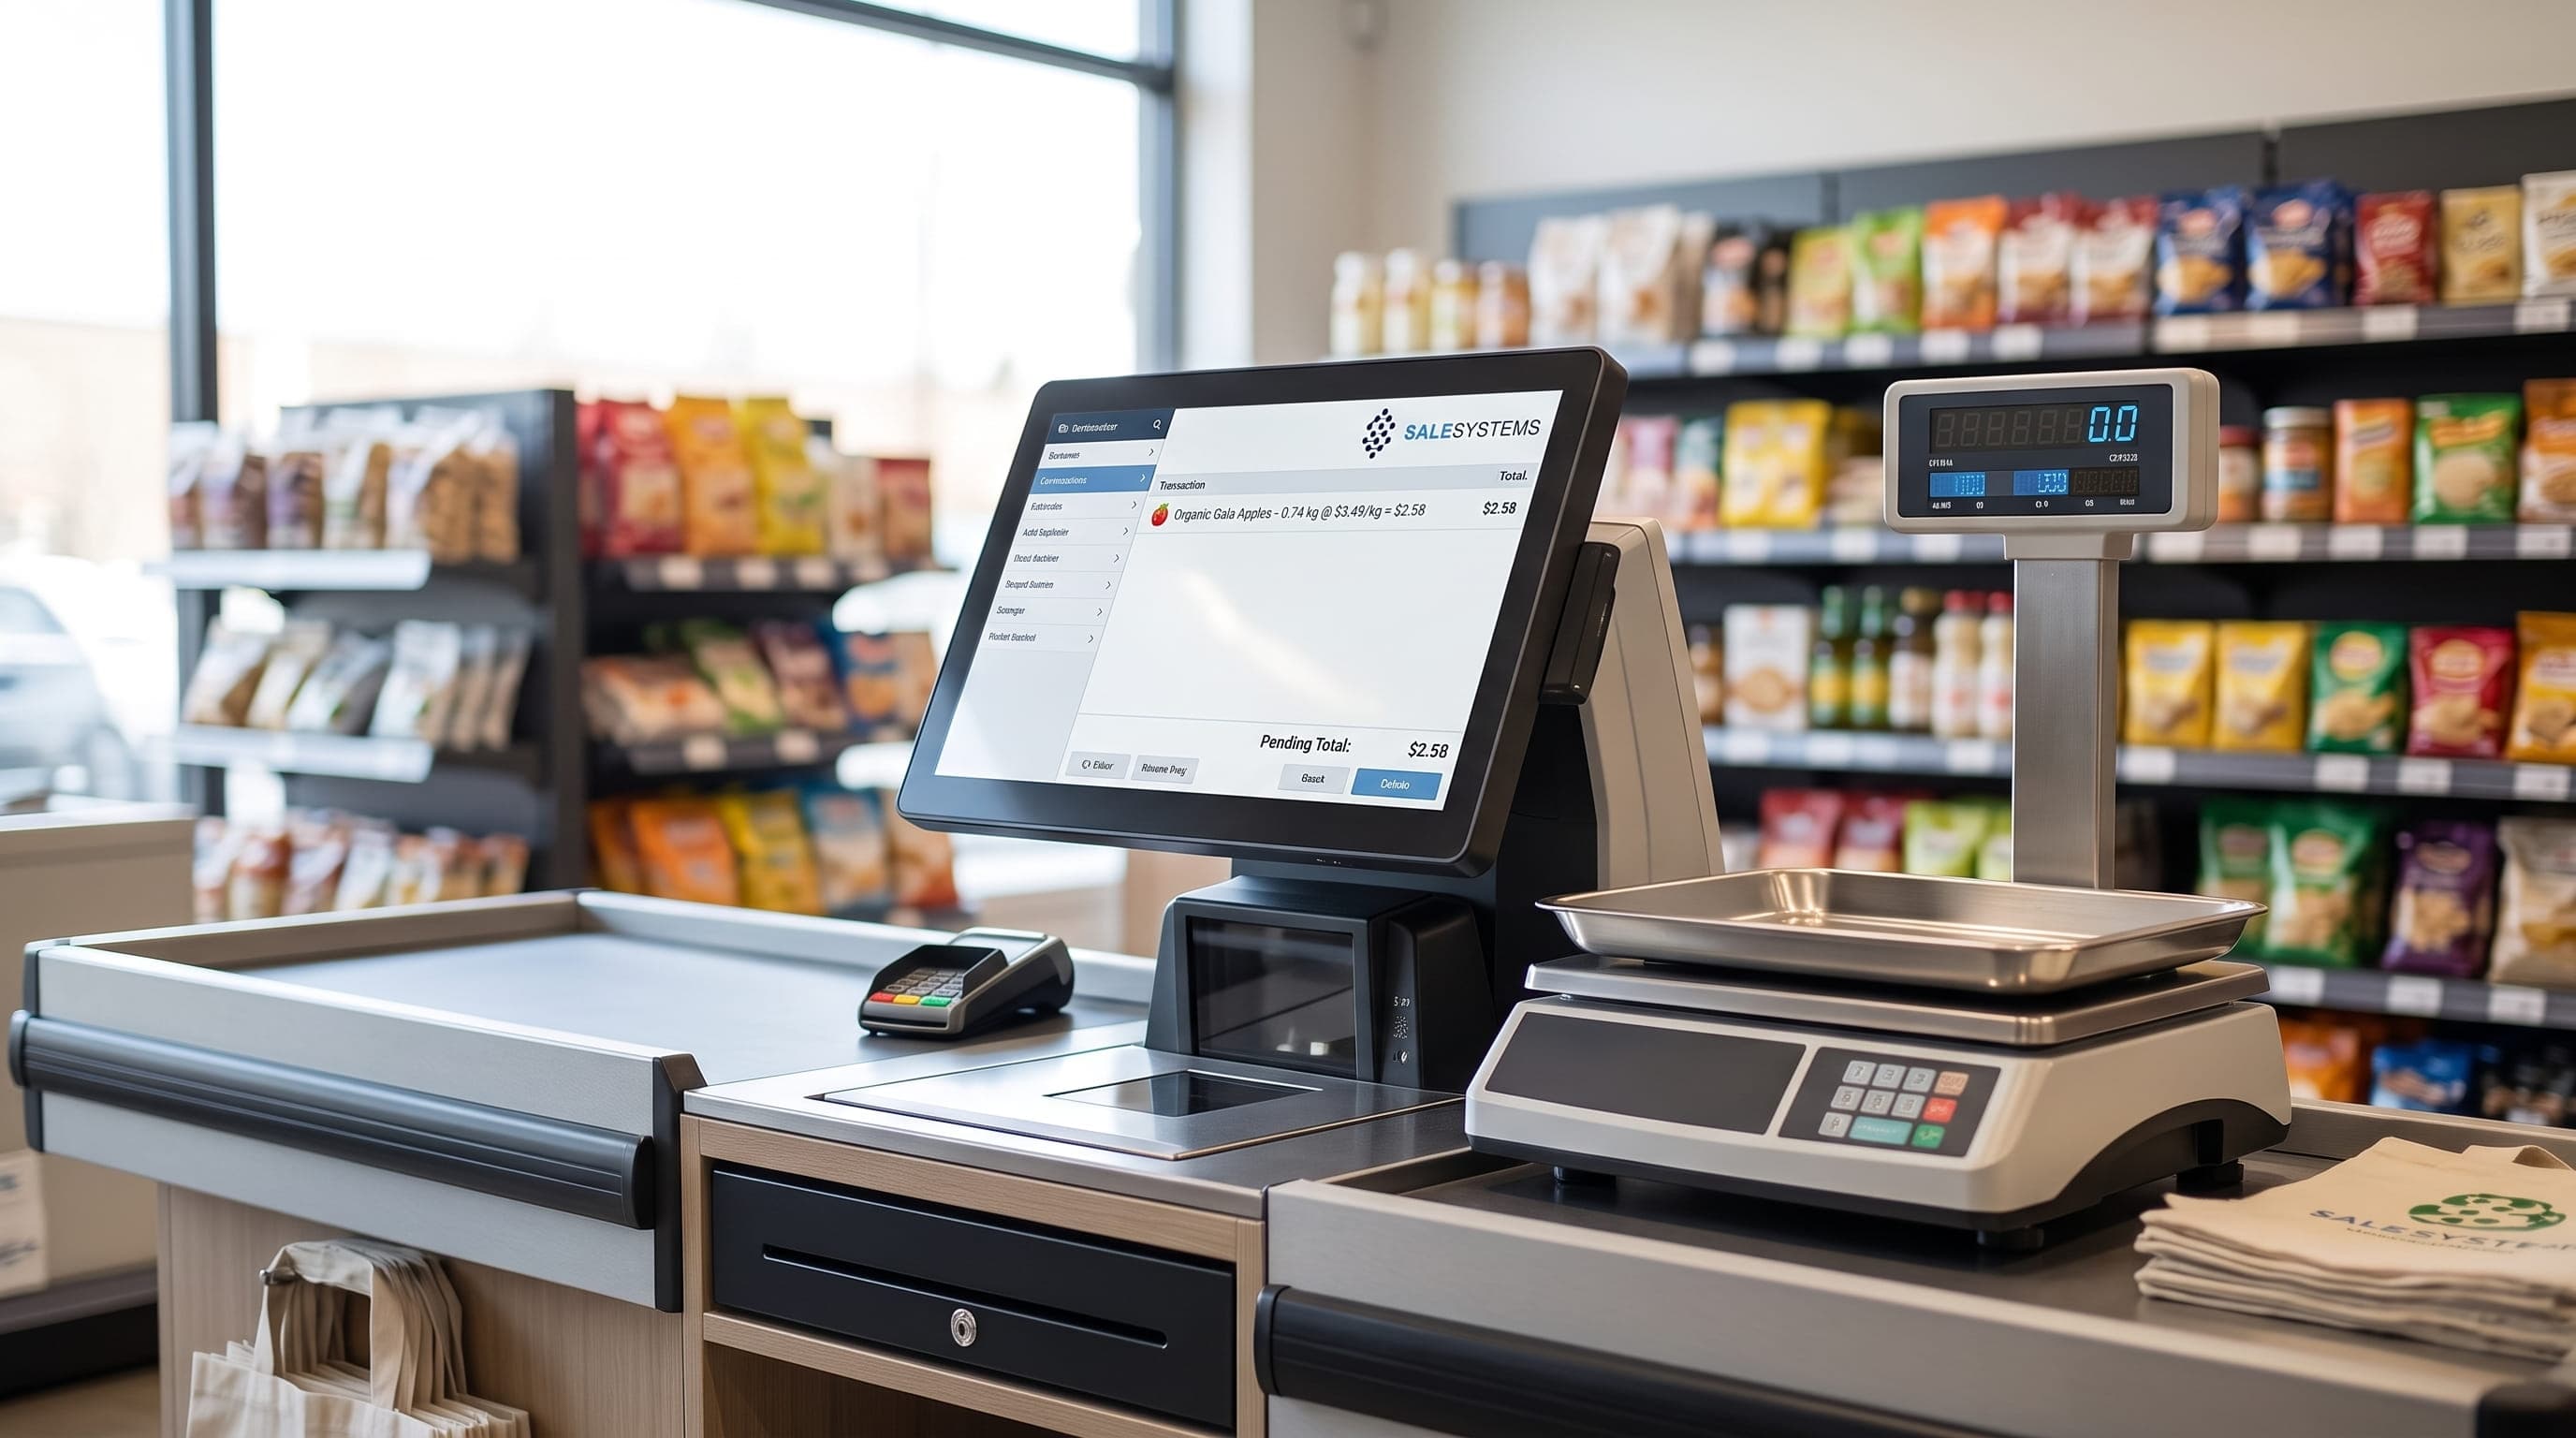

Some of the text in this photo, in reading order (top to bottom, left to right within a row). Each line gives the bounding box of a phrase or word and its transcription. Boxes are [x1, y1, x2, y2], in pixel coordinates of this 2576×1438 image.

[1404, 418, 1541, 440] SALESYSTEMS
[1174, 508, 1211, 522] Organic
[1213, 508, 1235, 521] Gala
[1237, 507, 1272, 521] Apples
[1281, 506, 1304, 519] 0.74
[1306, 506, 1320, 521] kg
[1321, 506, 1332, 521] @
[1334, 504, 1383, 520] $3.49/kg
[1394, 503, 1427, 517] $2.58
[1482, 501, 1517, 515] $2.58
[1260, 734, 1352, 754] Pending Total:
[1408, 741, 1449, 758] $2.58
